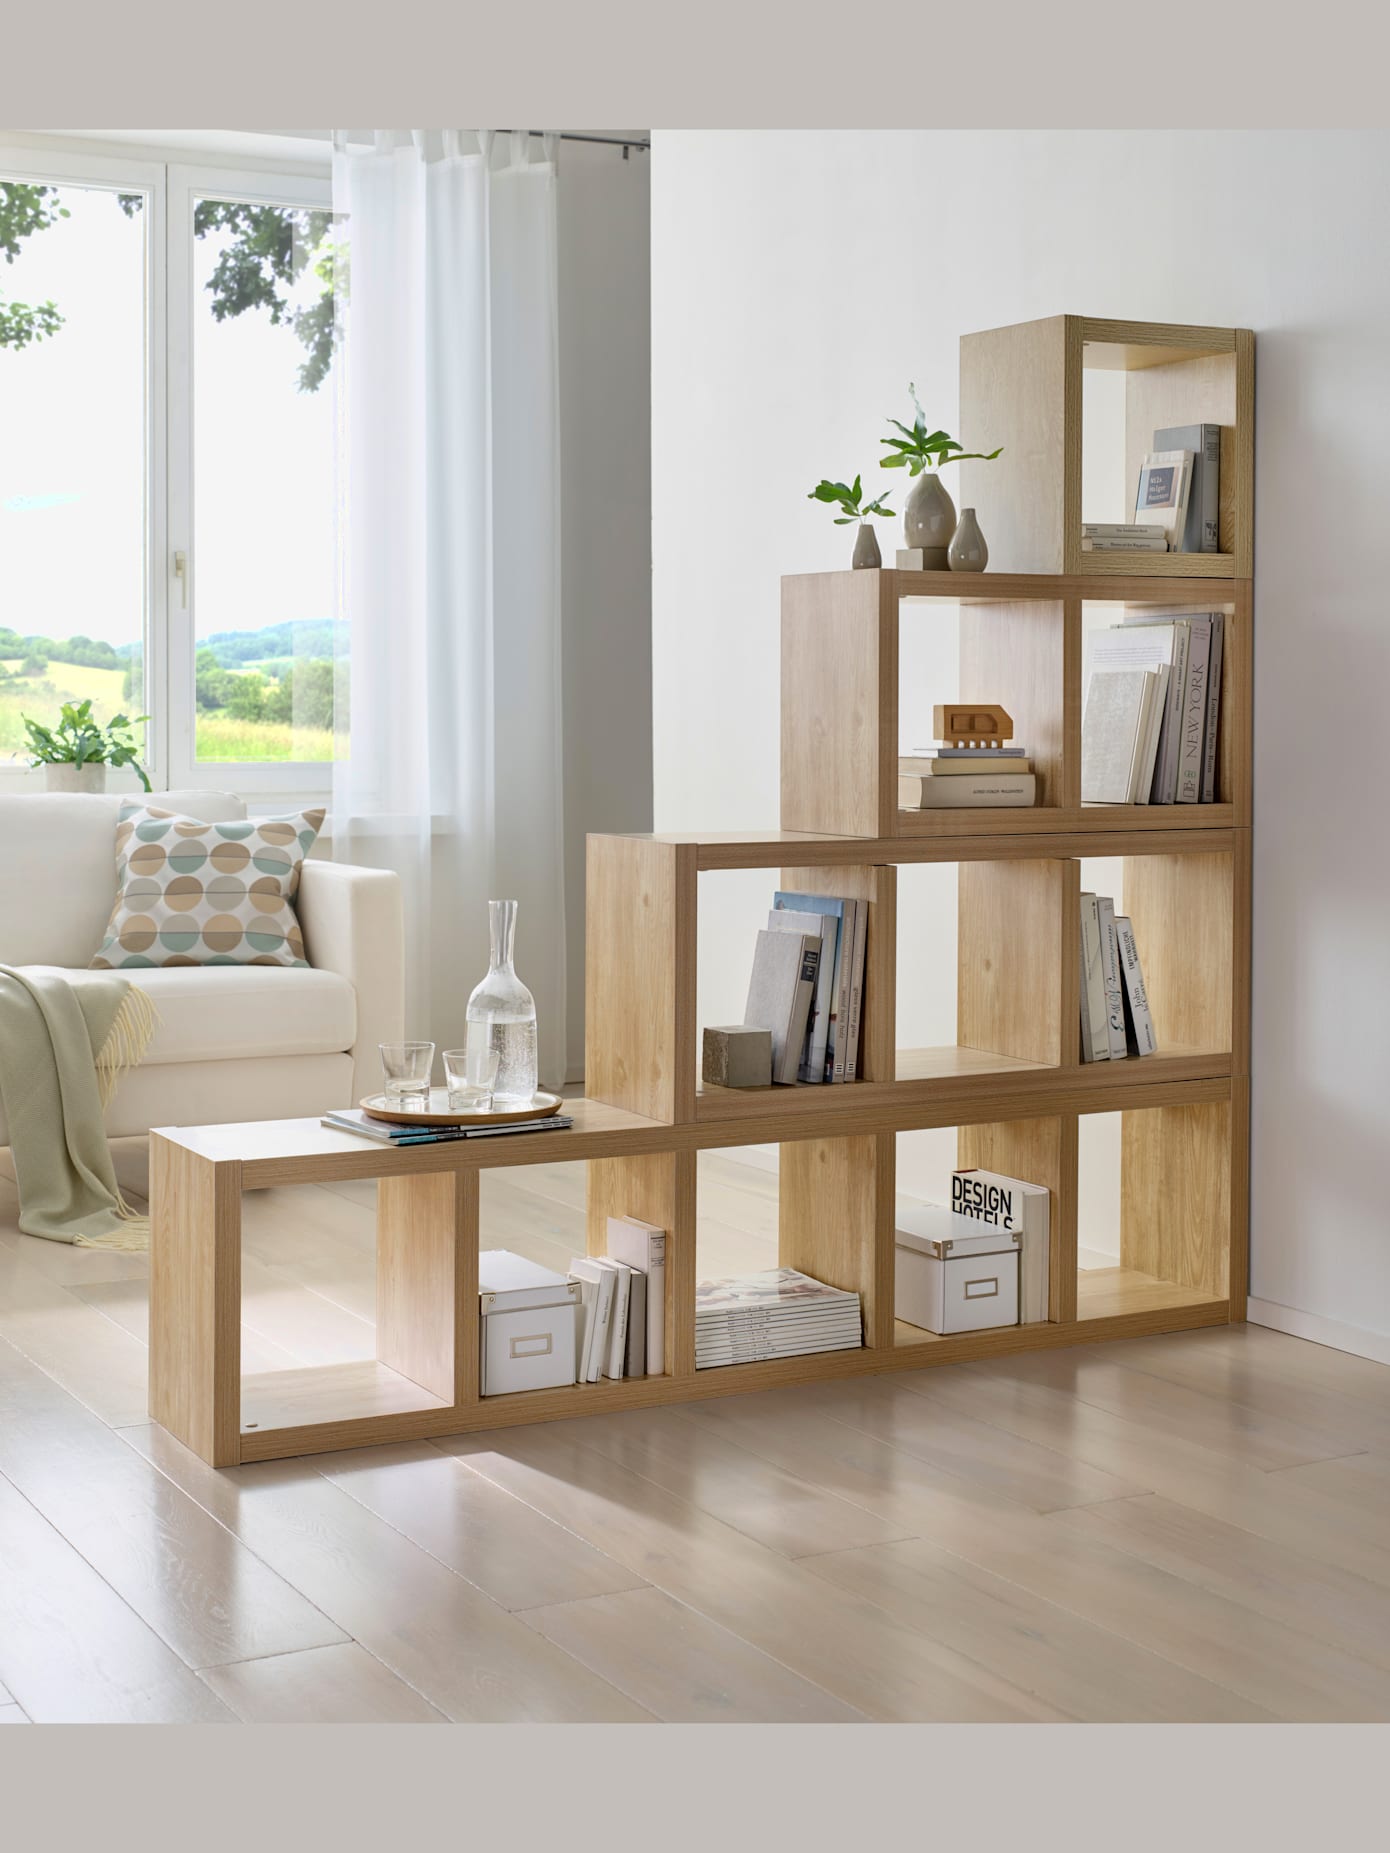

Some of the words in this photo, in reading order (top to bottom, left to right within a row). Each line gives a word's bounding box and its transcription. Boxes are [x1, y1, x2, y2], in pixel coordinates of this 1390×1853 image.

[1189, 663, 1204, 712] YORK
[1186, 714, 1199, 759] NEW
[1132, 987, 1143, 1008] John
[952, 1175, 1012, 1216] DESIGN
